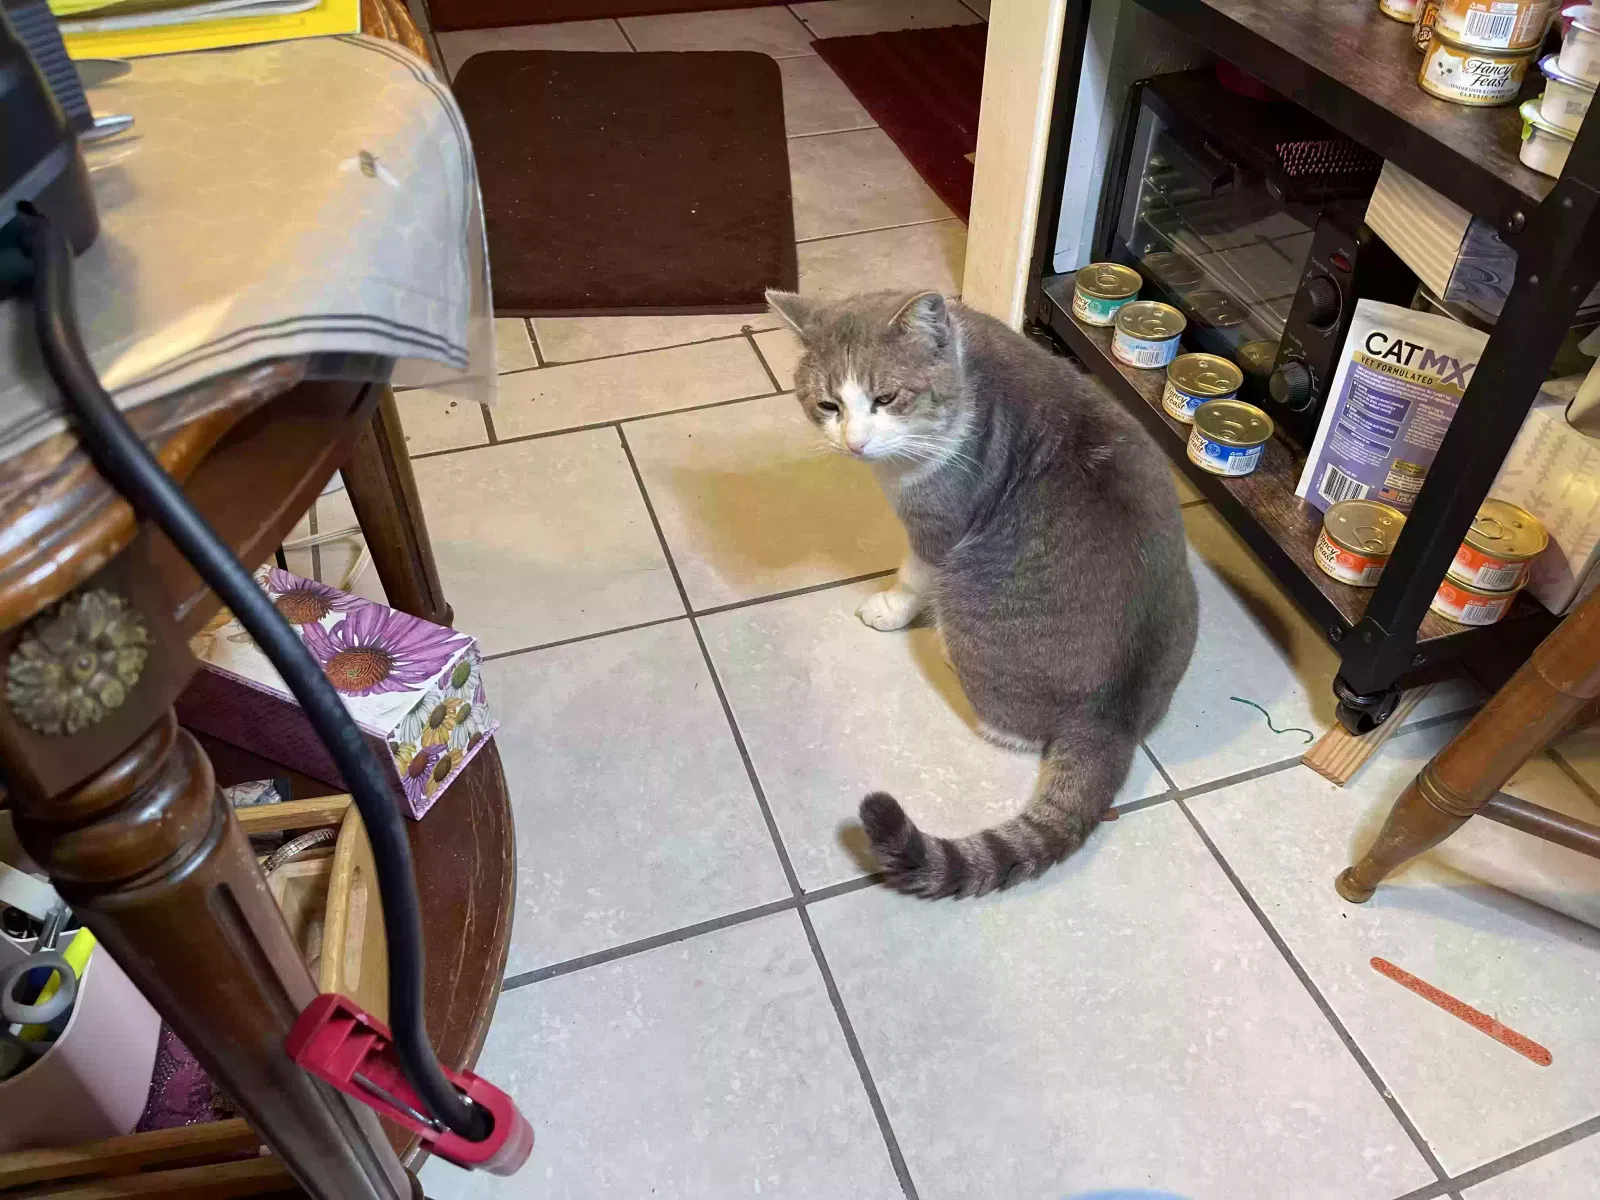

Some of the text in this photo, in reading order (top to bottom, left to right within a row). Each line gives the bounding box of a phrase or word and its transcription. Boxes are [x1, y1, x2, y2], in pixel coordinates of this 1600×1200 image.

[1419, 31, 1432, 41] GRA
[1468, 59, 1516, 78] Fancy
[1469, 73, 1509, 87] Feast
[1459, 92, 1487, 100] CLASSIC
[1361, 355, 1375, 367] VET
[1376, 361, 1434, 385] FORMULATED
[1166, 395, 1186, 410] Feast
[1168, 386, 1188, 403] Fancy
[1317, 542, 1335, 562] Feast
[1319, 533, 1339, 555] Fancy
